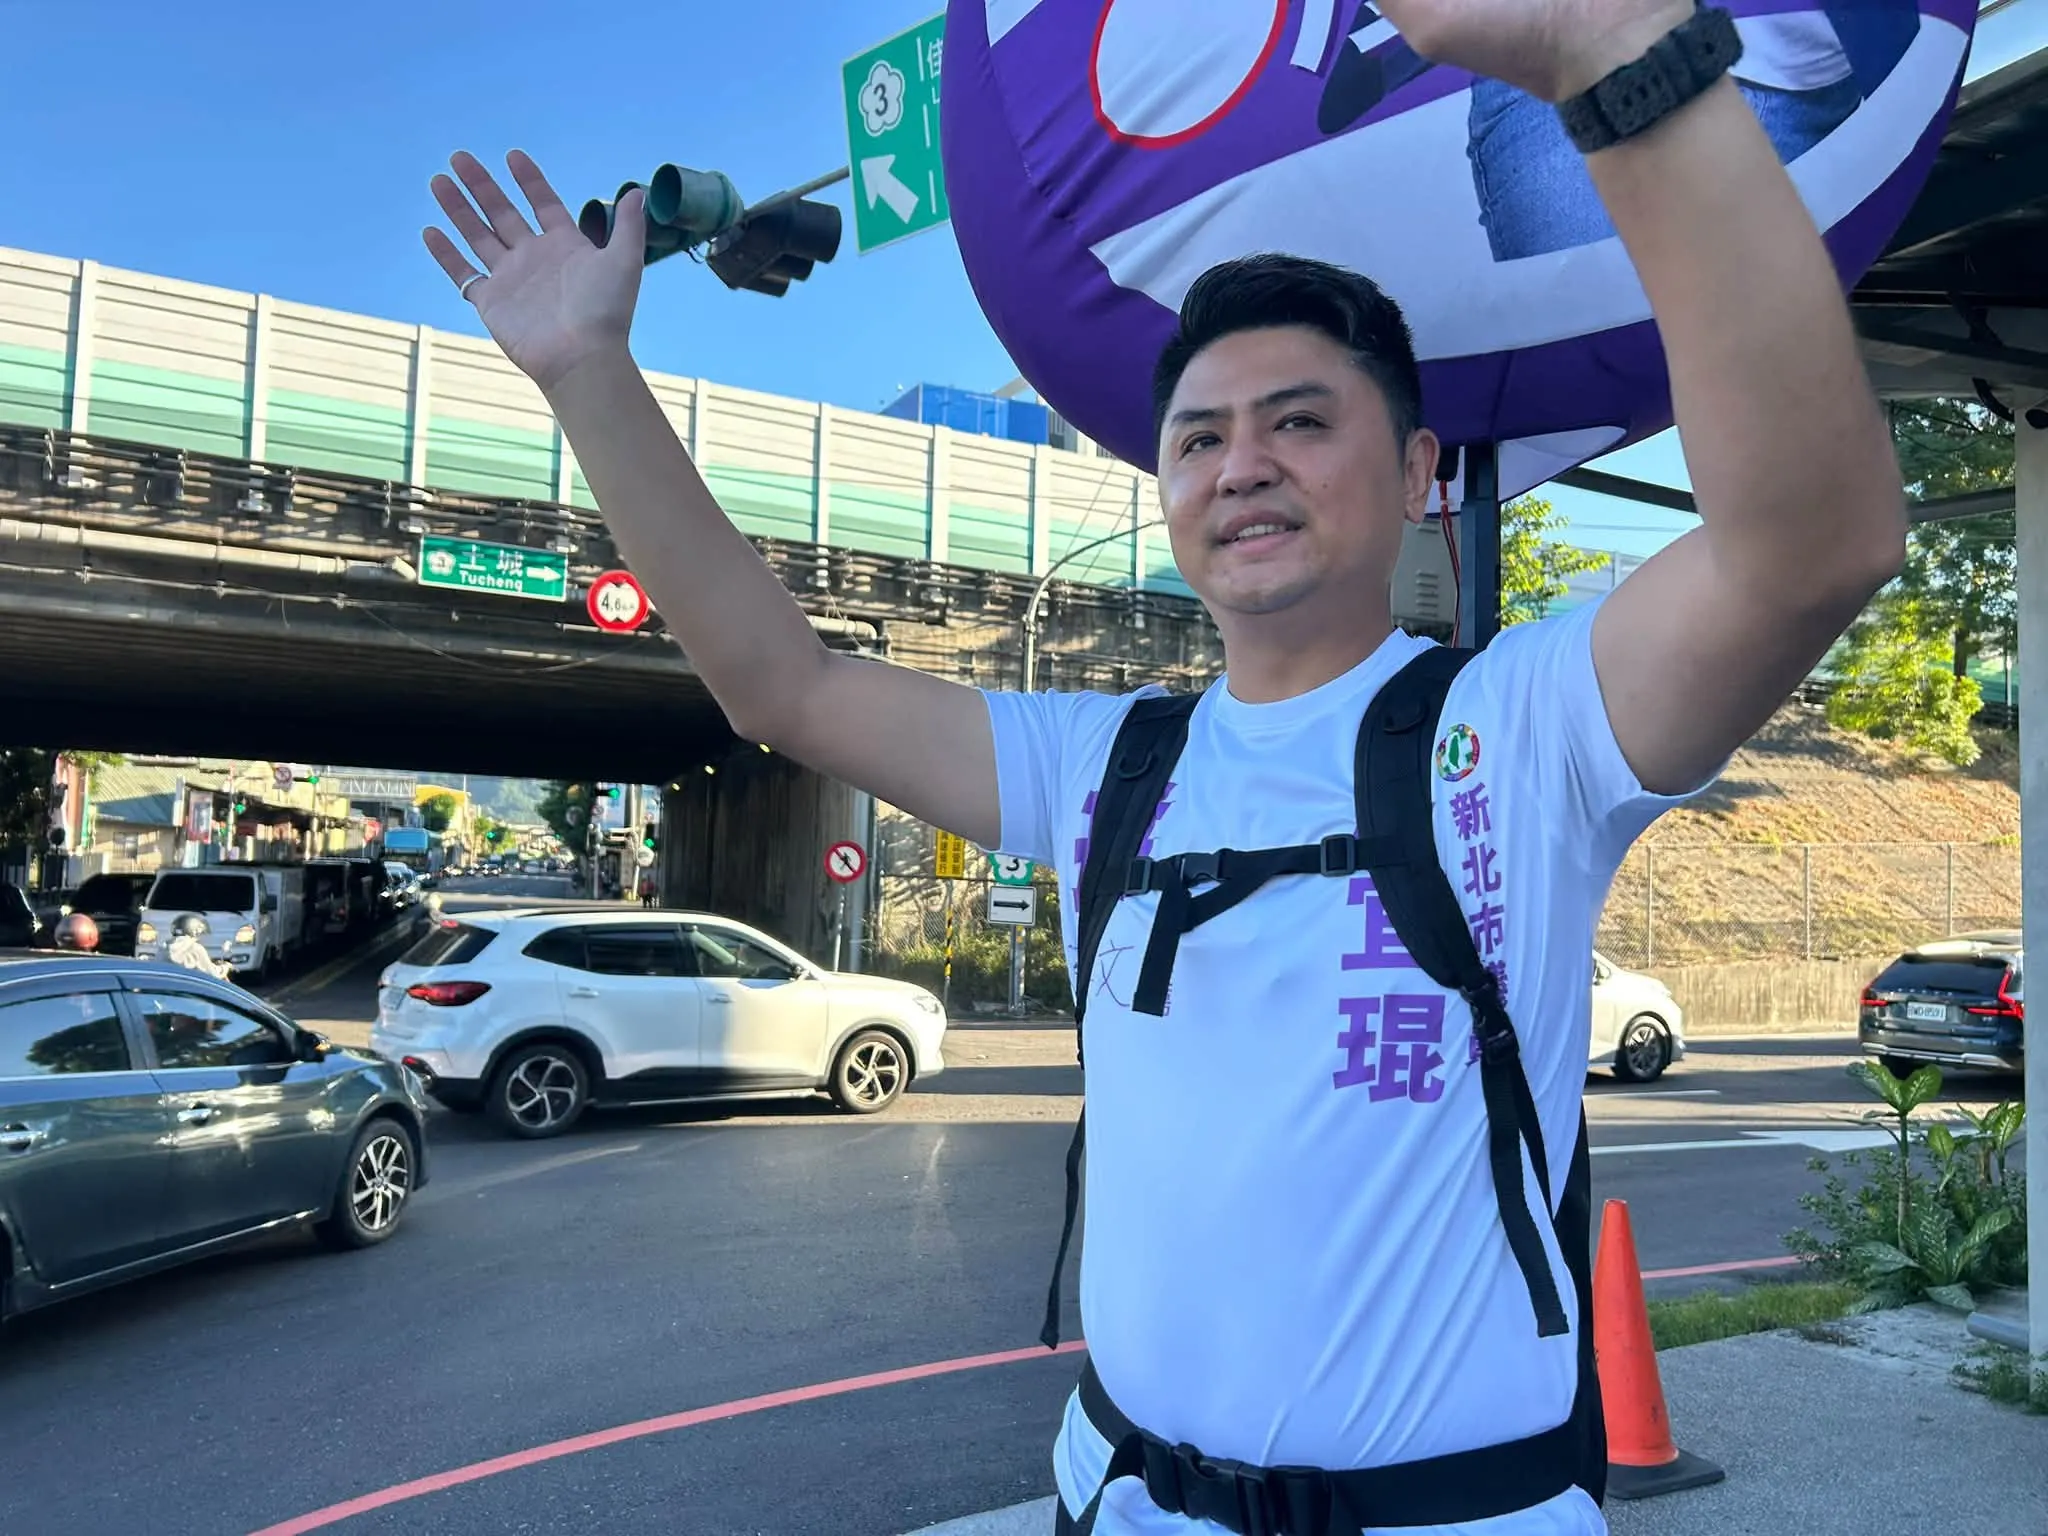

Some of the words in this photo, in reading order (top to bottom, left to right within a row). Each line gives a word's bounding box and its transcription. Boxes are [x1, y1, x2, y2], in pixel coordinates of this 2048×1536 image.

[873, 82, 889, 117] 3
[459, 570, 523, 592] Tucheng
[1449, 782, 1508, 1066] 新北市
